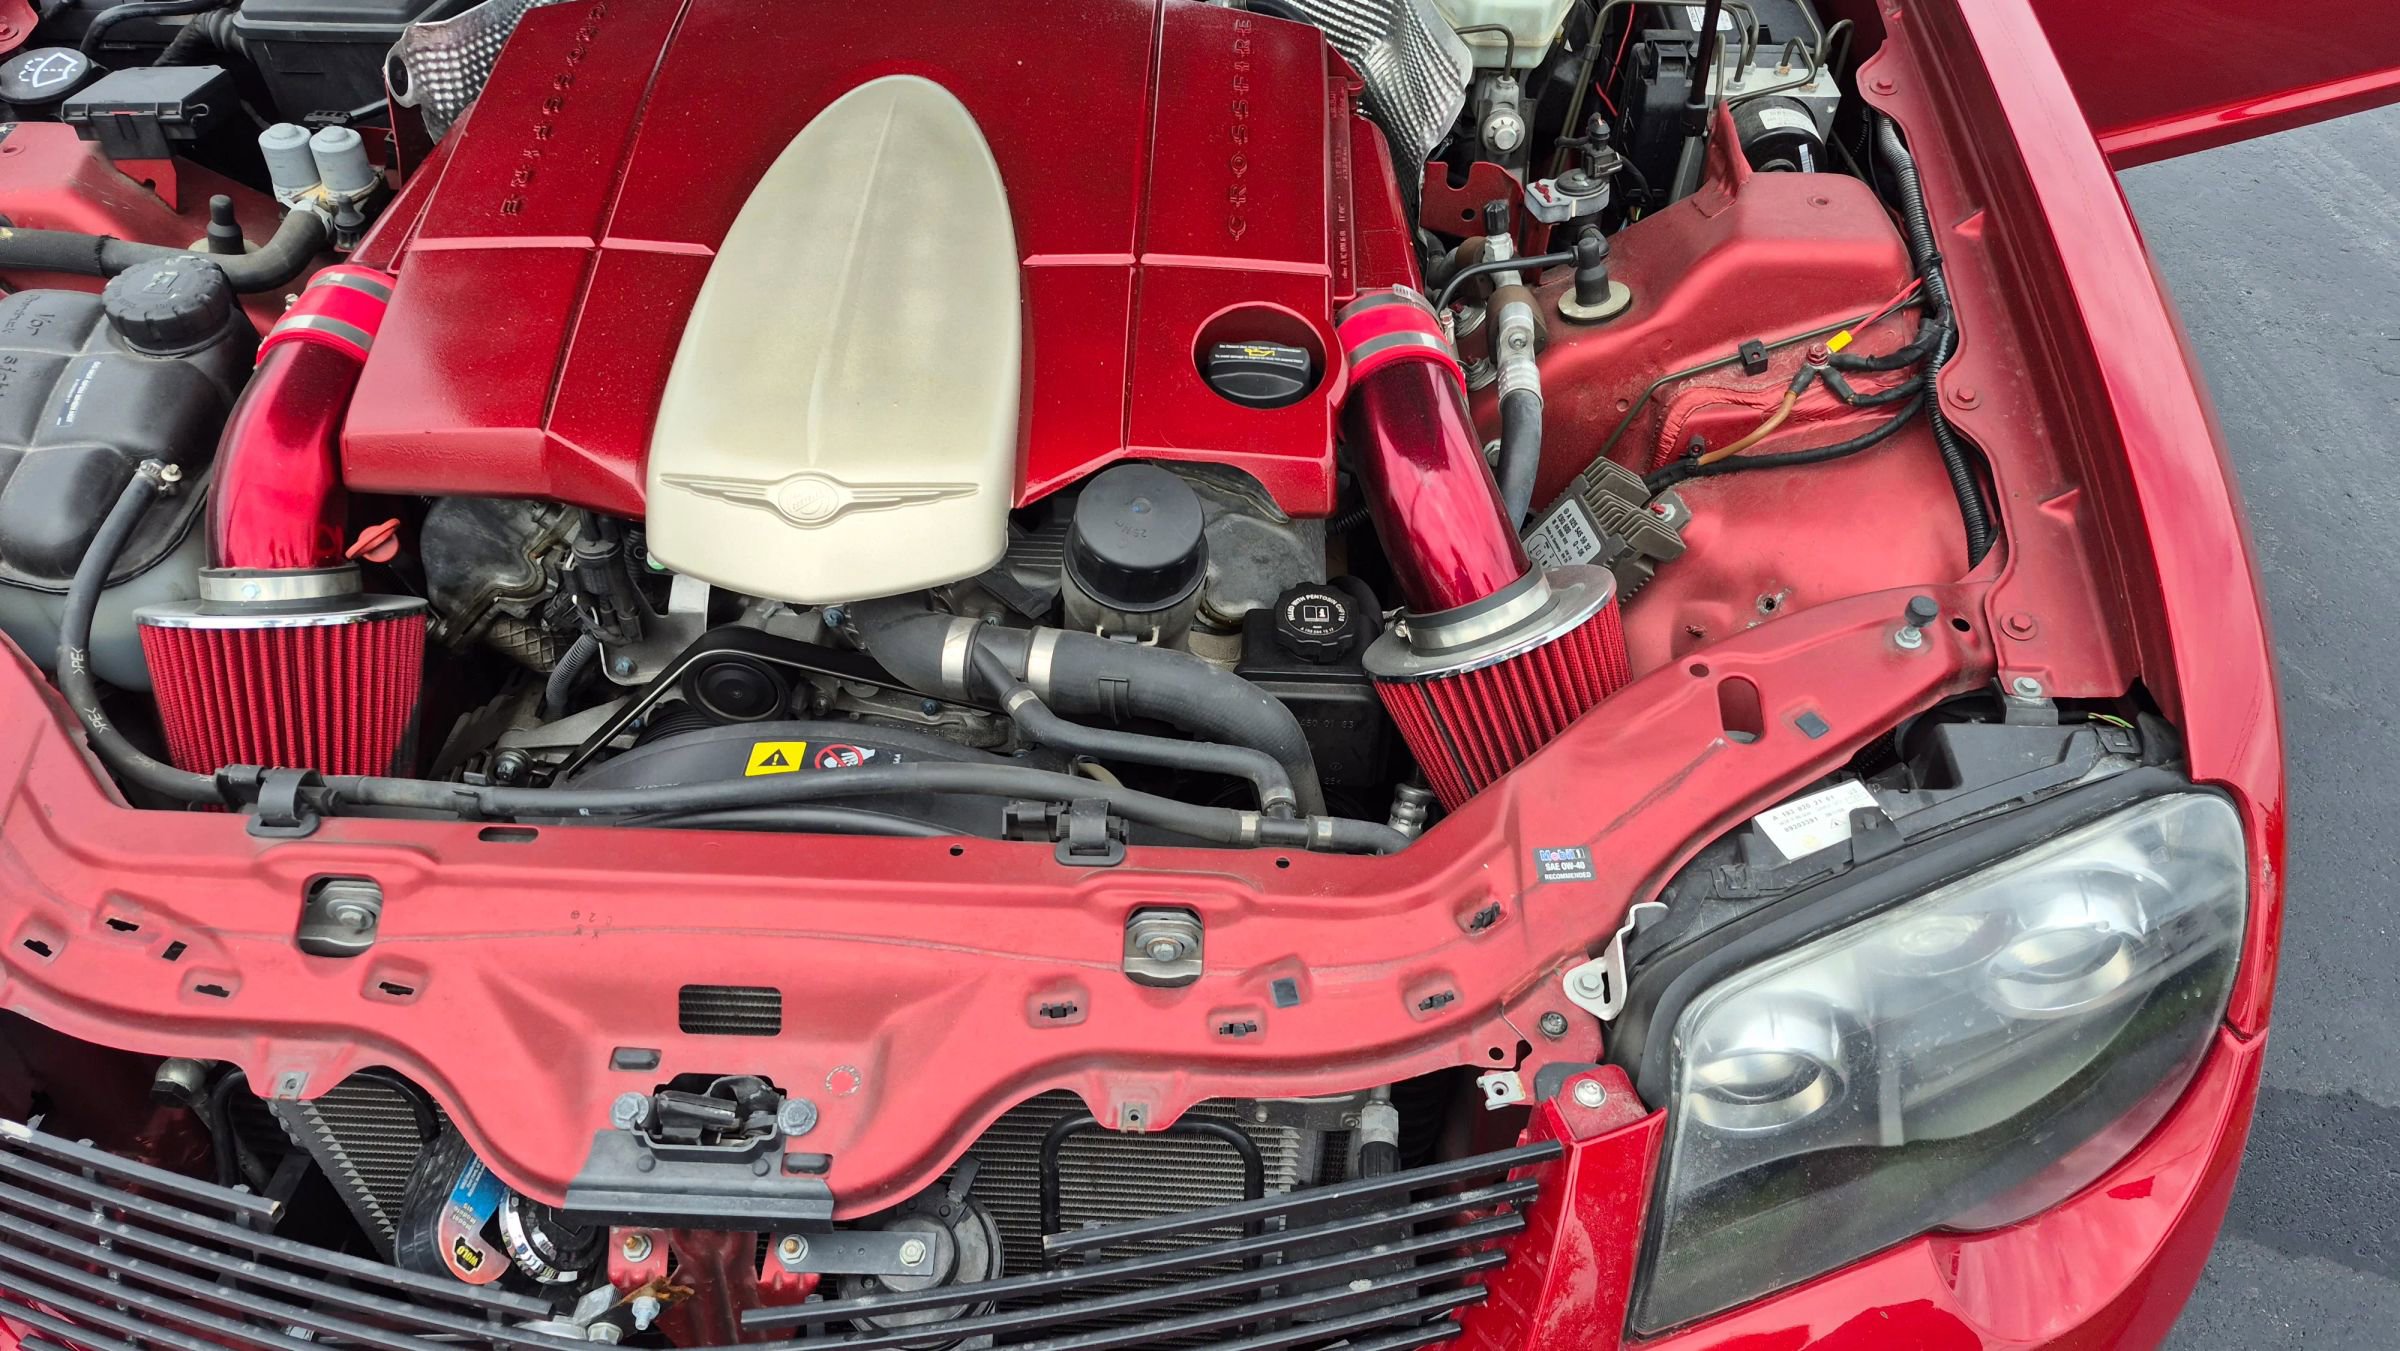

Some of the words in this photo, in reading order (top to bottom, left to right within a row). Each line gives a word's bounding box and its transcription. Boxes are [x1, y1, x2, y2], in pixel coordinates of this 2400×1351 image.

[1228, 18, 1251, 241] CROSSFIRE
[1291, 596, 1306, 606] WITH
[1305, 594, 1338, 605] PENTOSIN
[1287, 605, 1296, 622] FILLED
[1539, 849, 1574, 861] Mobil
[1545, 862, 1561, 871] SAE
[1560, 861, 1586, 871] 0W-40
[1544, 871, 1592, 880] RECOMMENDED
[456, 1245, 479, 1267] WOLO
